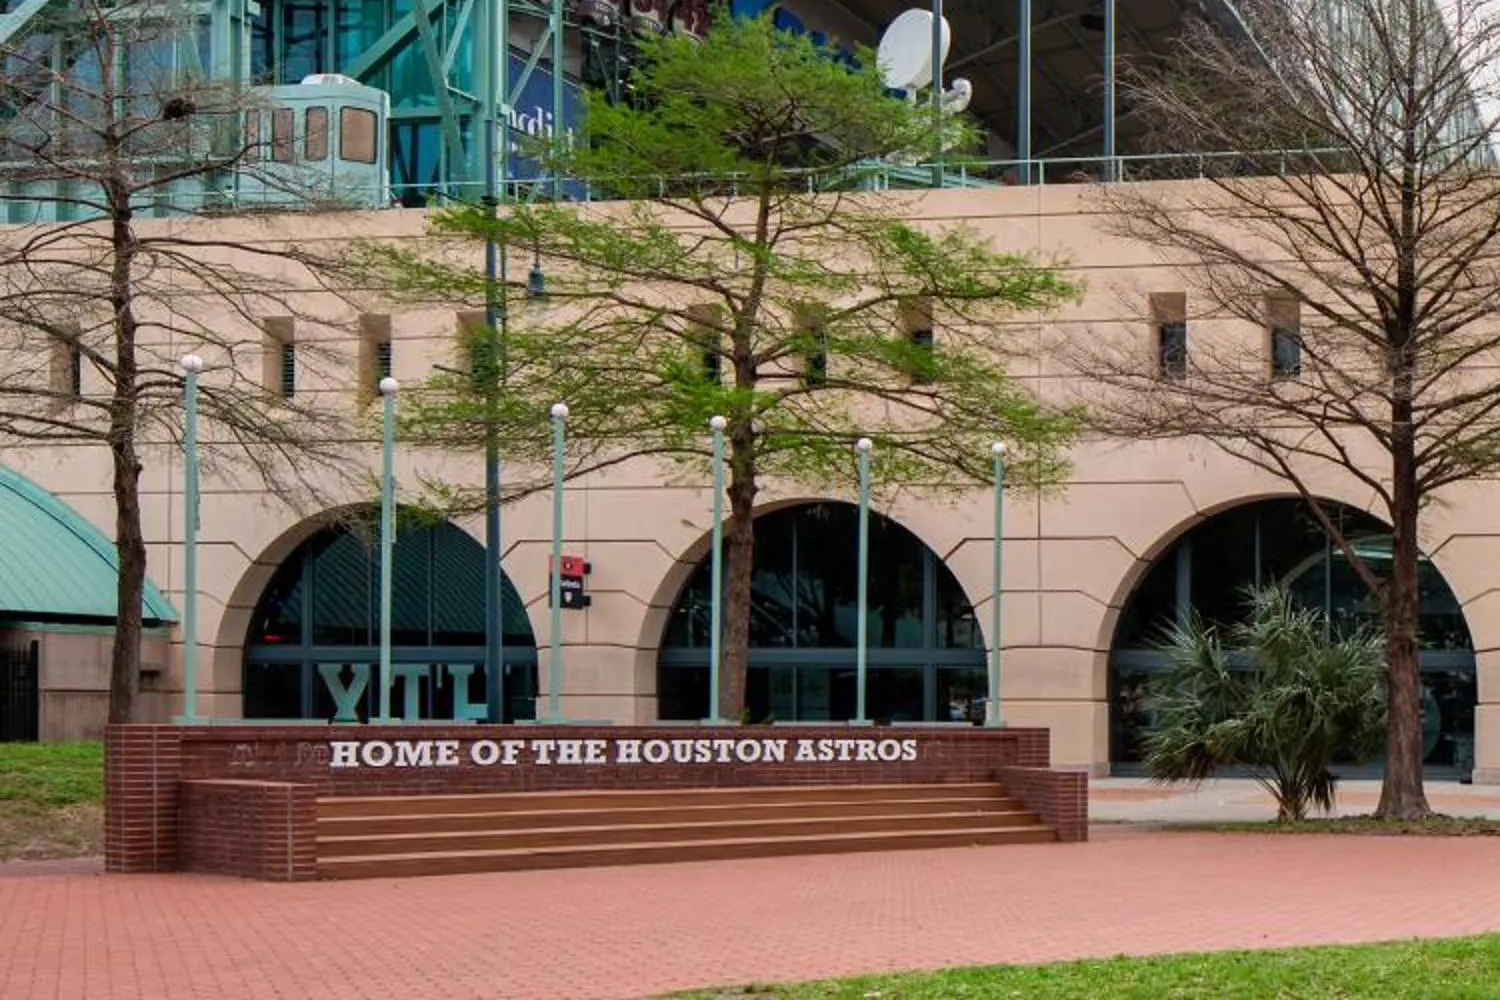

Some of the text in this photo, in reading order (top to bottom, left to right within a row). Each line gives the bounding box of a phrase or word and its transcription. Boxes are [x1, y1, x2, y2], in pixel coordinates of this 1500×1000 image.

[329, 738, 917, 767] HOME OF THE HOUSTON ASTROS
